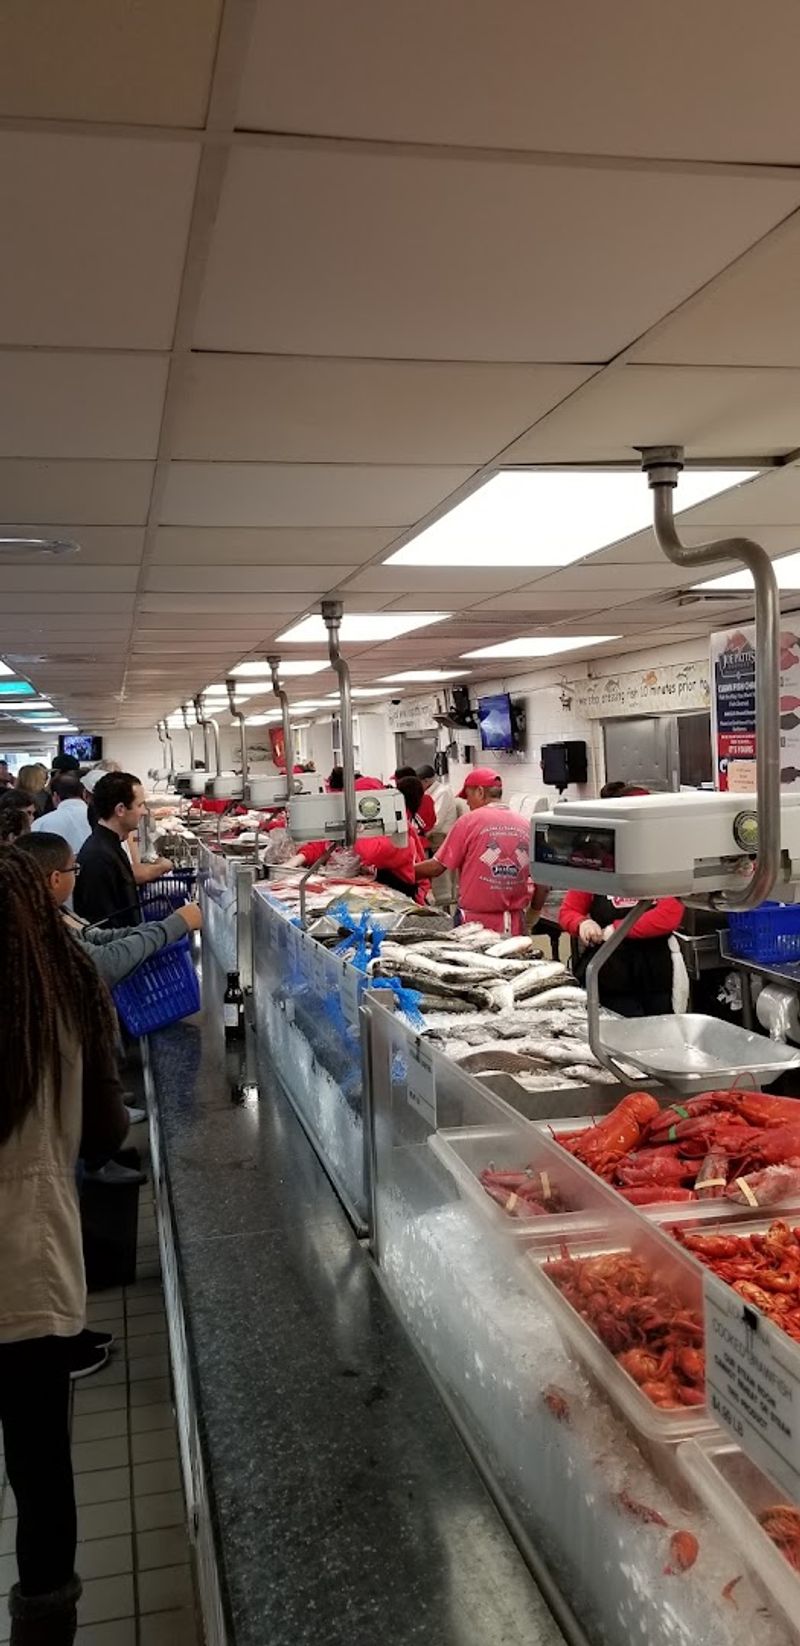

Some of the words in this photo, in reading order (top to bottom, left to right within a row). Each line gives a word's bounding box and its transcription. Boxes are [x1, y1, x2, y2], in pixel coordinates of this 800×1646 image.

[712, 1317, 745, 1358] COOKED
[737, 1364, 755, 1387] STEAM
[714, 1354, 736, 1380] CANNOT
[770, 1411, 792, 1438] STEAM
[733, 1416, 744, 1437] LB
[741, 1398, 768, 1428] PRODUCT
